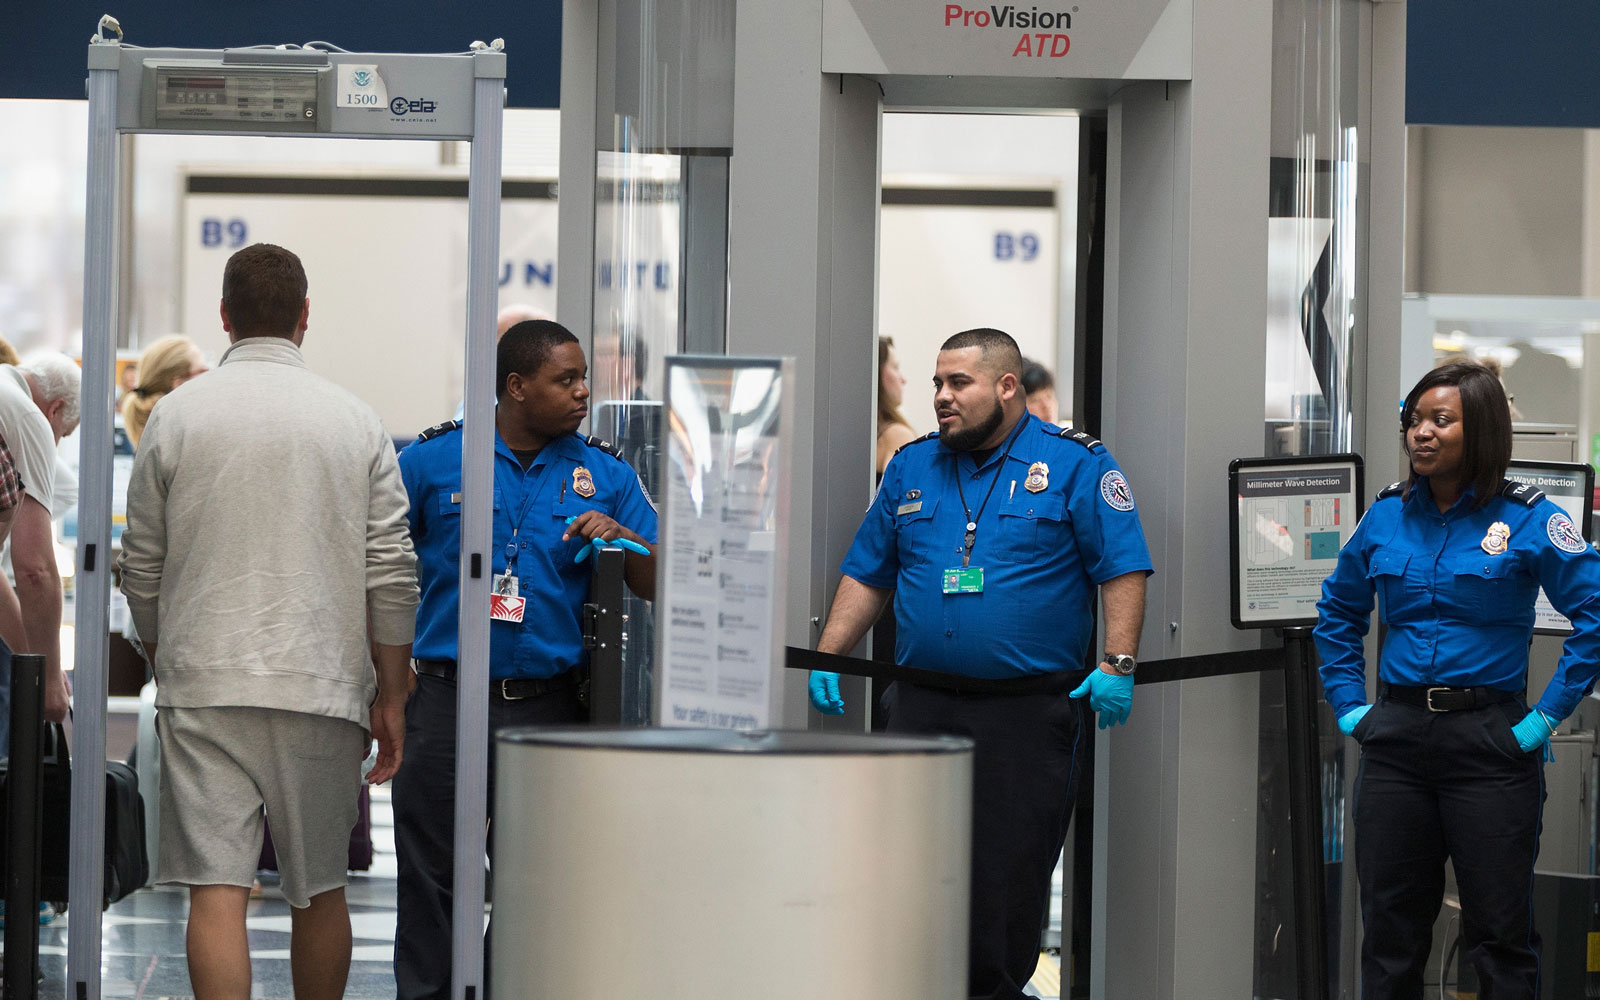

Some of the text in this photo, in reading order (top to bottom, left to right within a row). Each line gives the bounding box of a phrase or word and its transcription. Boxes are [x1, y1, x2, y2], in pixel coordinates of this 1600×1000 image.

[945, 4, 1072, 29] ProVision
[1012, 33, 1071, 57] ATD
[346, 93, 378, 105] 1500
[202, 219, 246, 248] B9
[994, 233, 1039, 261] B9
[1246, 477, 1340, 489] Millimeter Wave Detection
[1513, 475, 1536, 485] Wave
[1537, 477, 1576, 488] Detection
